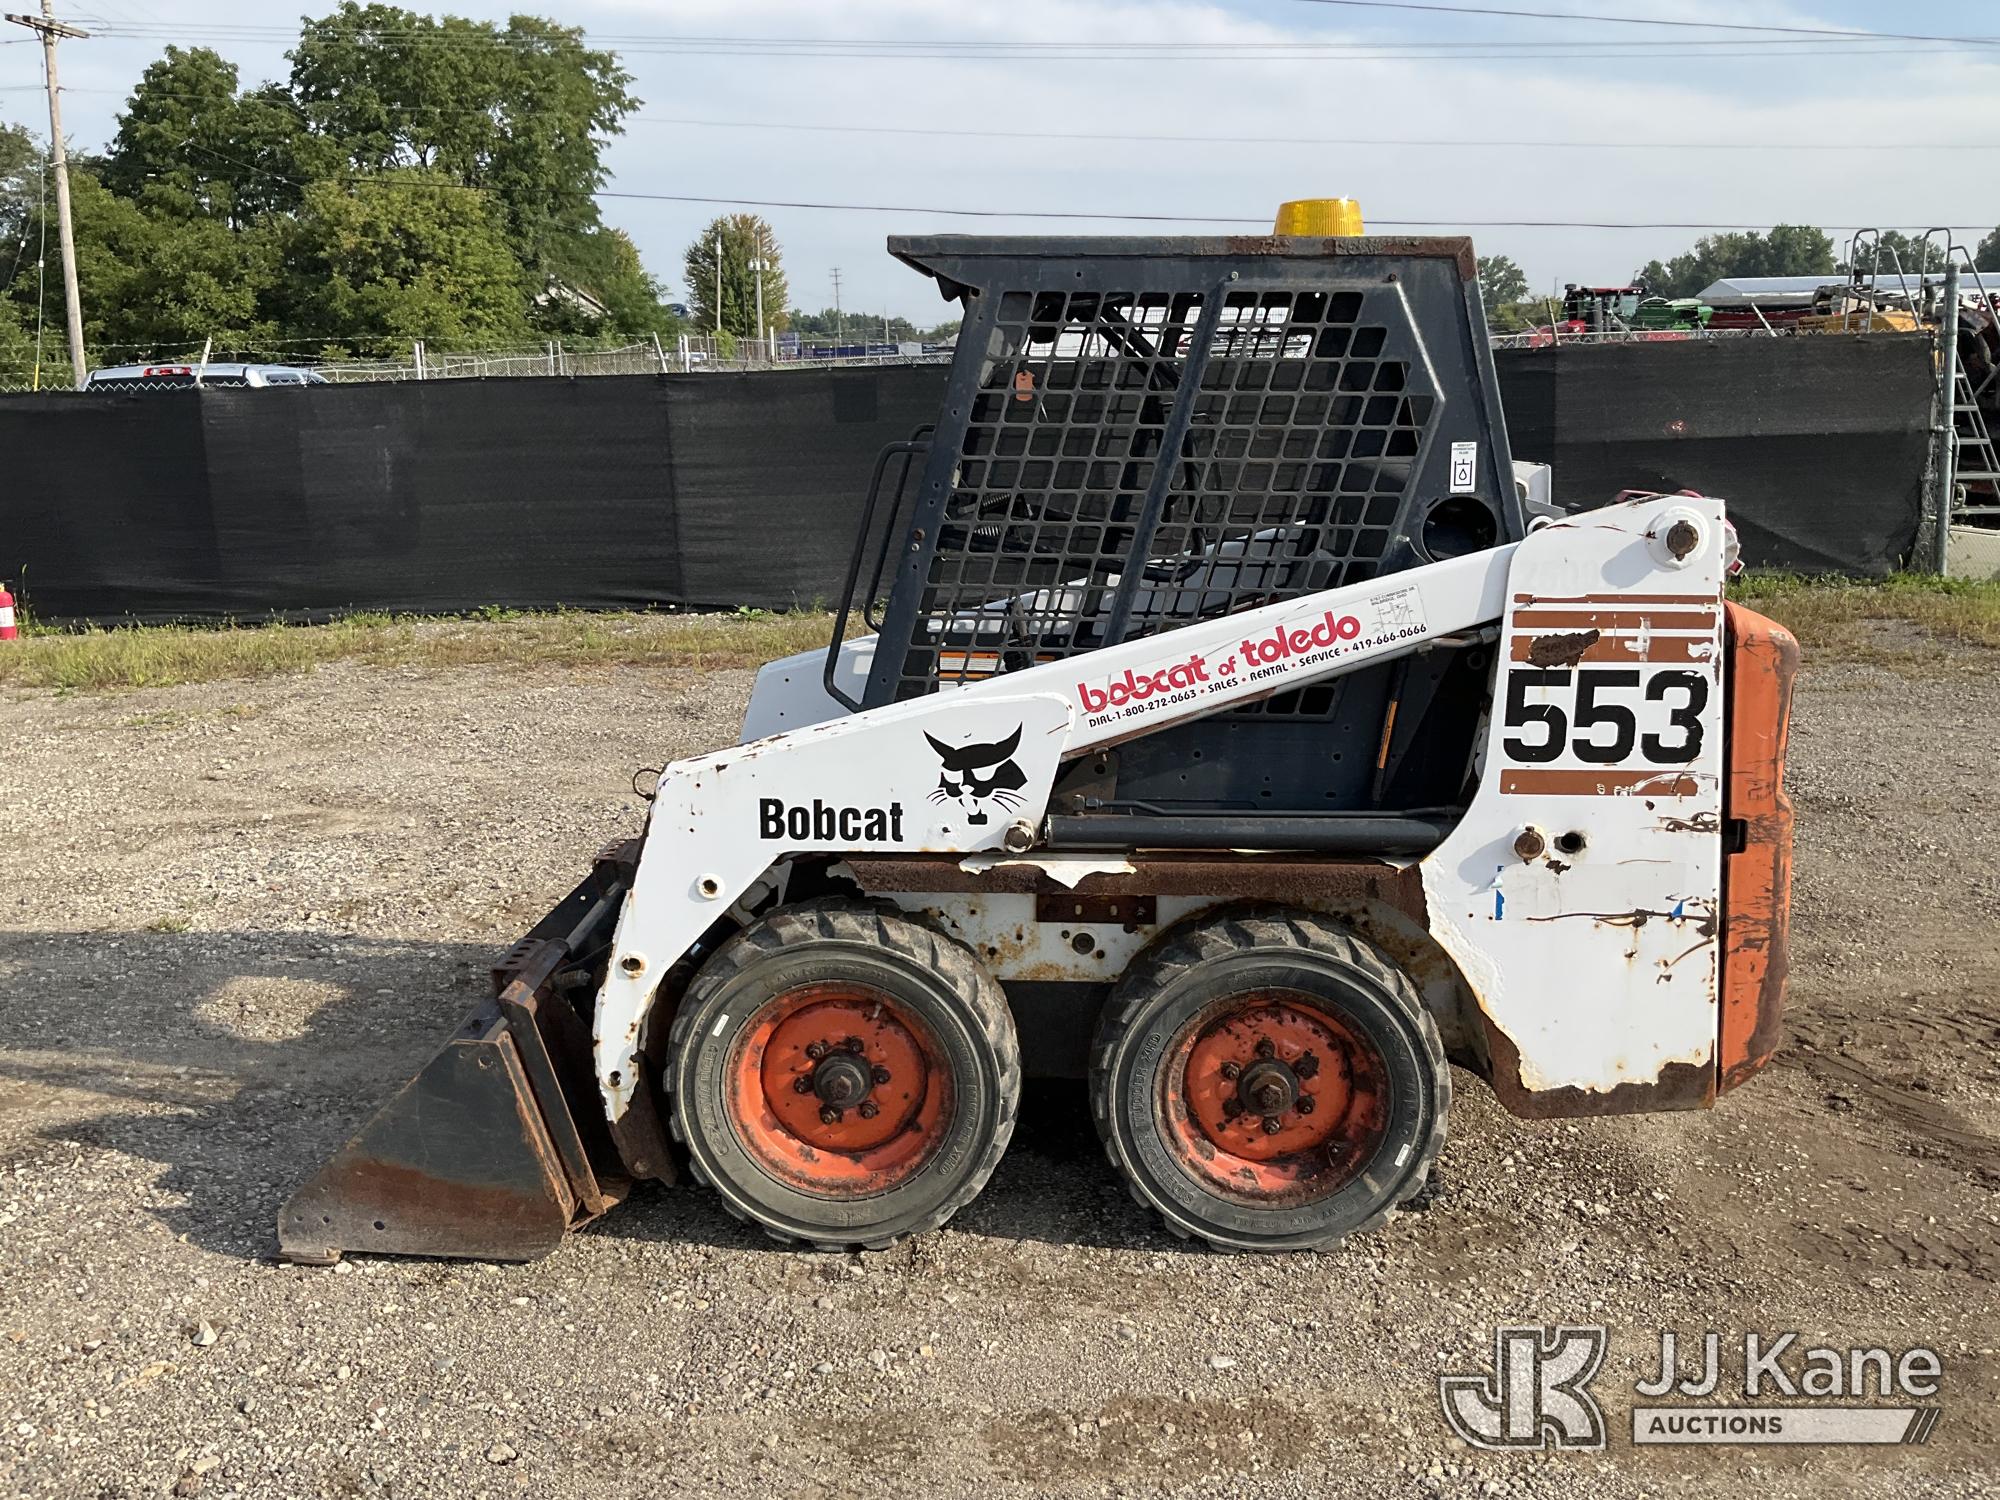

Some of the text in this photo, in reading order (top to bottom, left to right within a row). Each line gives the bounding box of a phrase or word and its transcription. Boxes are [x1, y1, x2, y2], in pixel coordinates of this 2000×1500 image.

[1078, 611, 1360, 713] bobcat of toledo
[1089, 624, 1427, 728] DIAL-1-800-272-0663 SALES RENTAL SERVICE 419-666-0666
[1503, 669, 1708, 763] 553
[759, 798, 904, 842] Bobcat
